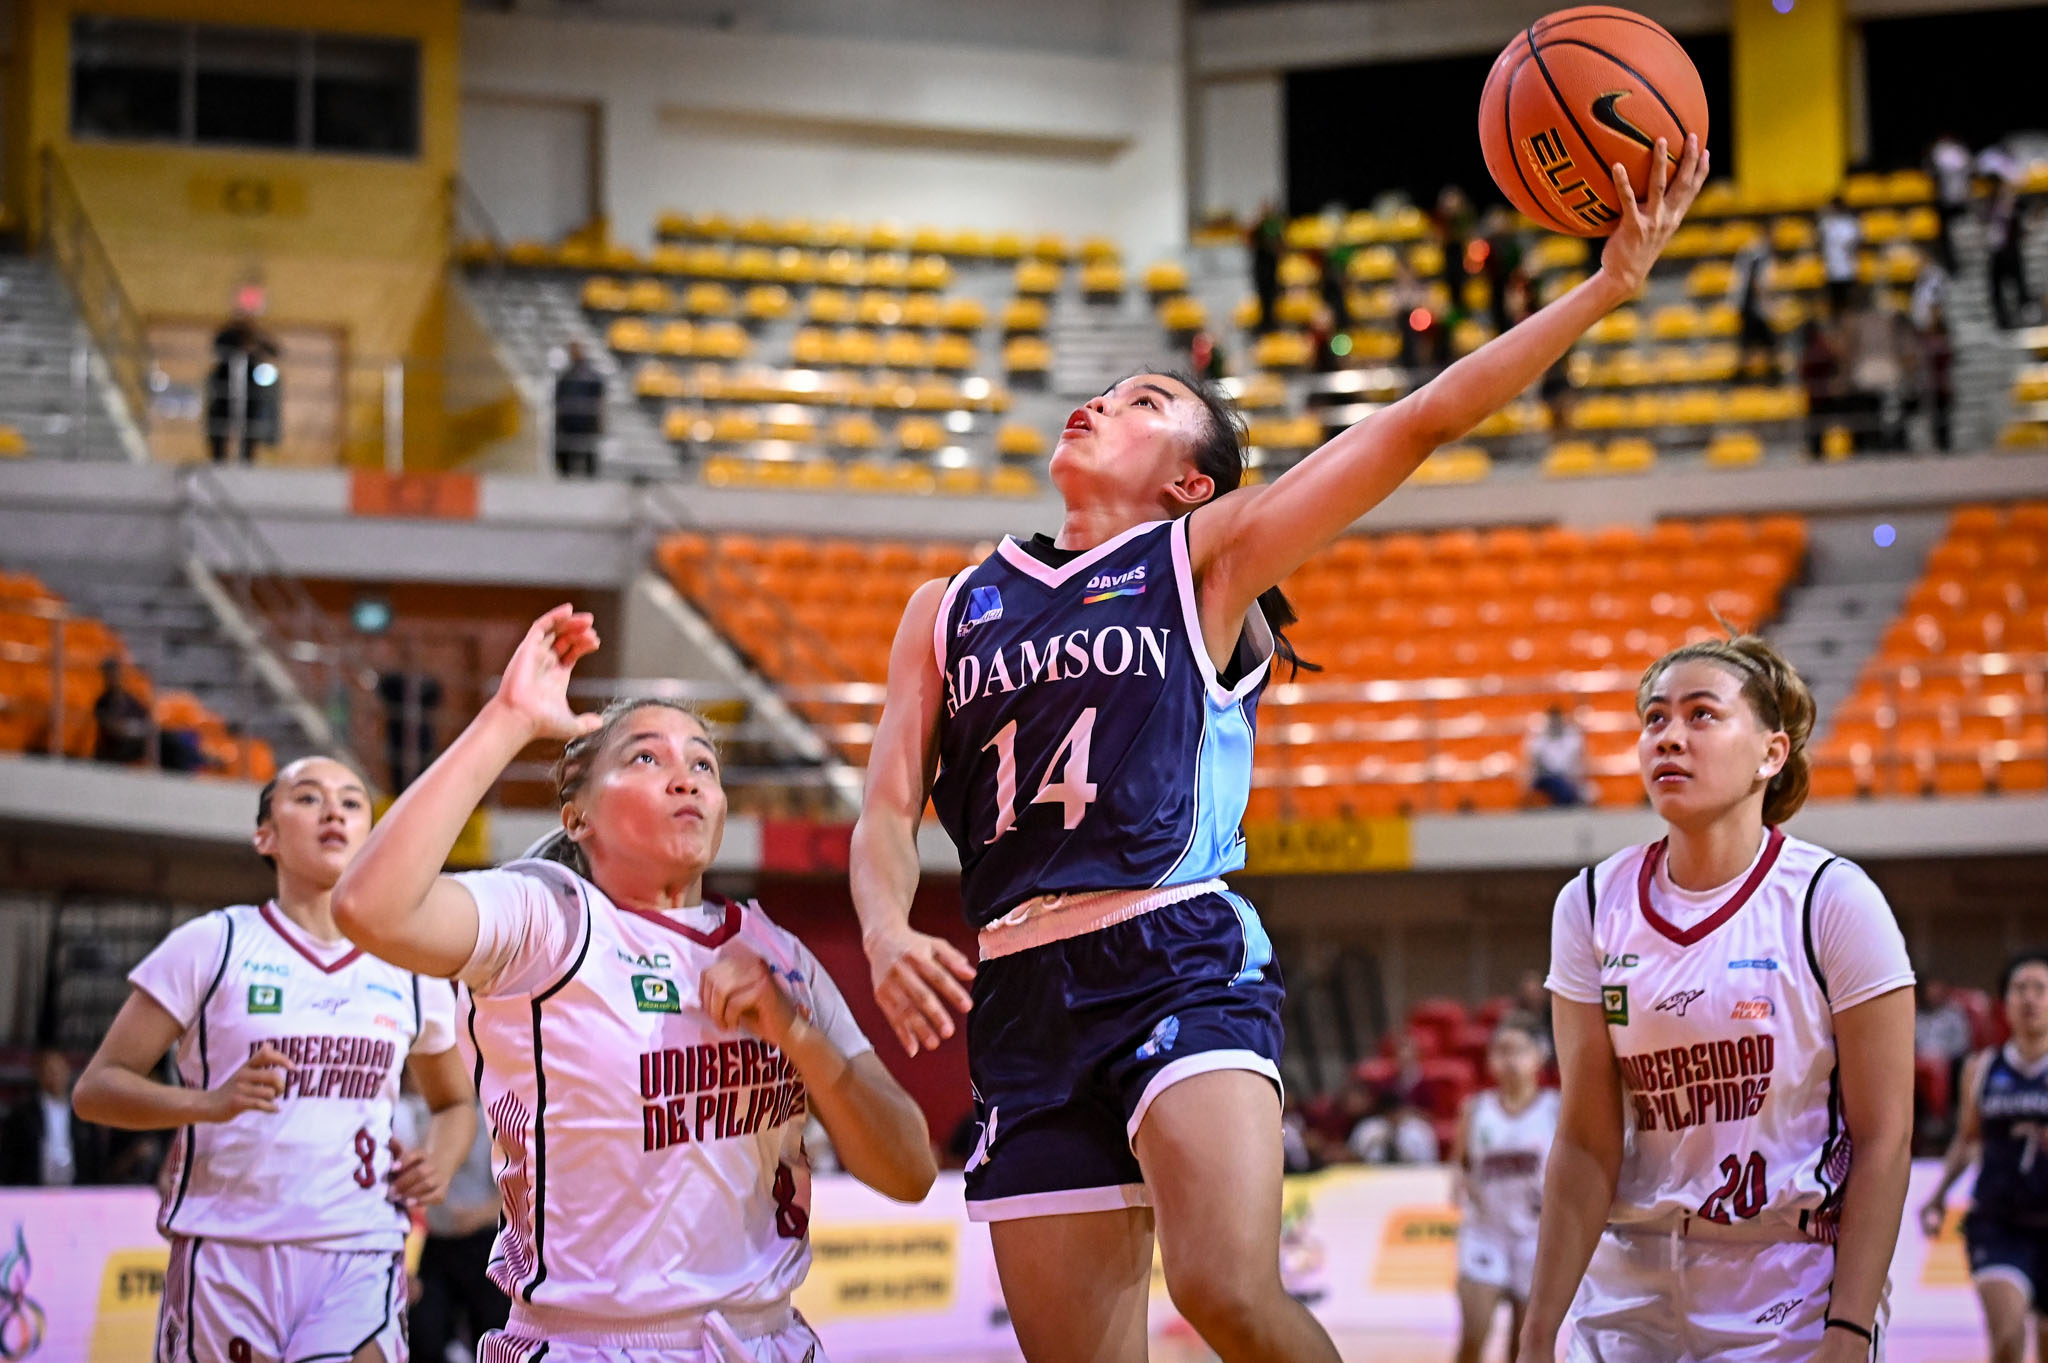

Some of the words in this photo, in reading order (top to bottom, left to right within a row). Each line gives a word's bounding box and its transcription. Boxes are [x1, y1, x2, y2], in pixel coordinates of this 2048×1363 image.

[1086, 565, 1146, 589] DAVIES
[945, 624, 1172, 720] ADAMSON
[980, 706, 1098, 845] 14
[772, 1161, 810, 1241] 8
[1697, 1149, 1768, 1226] 20
